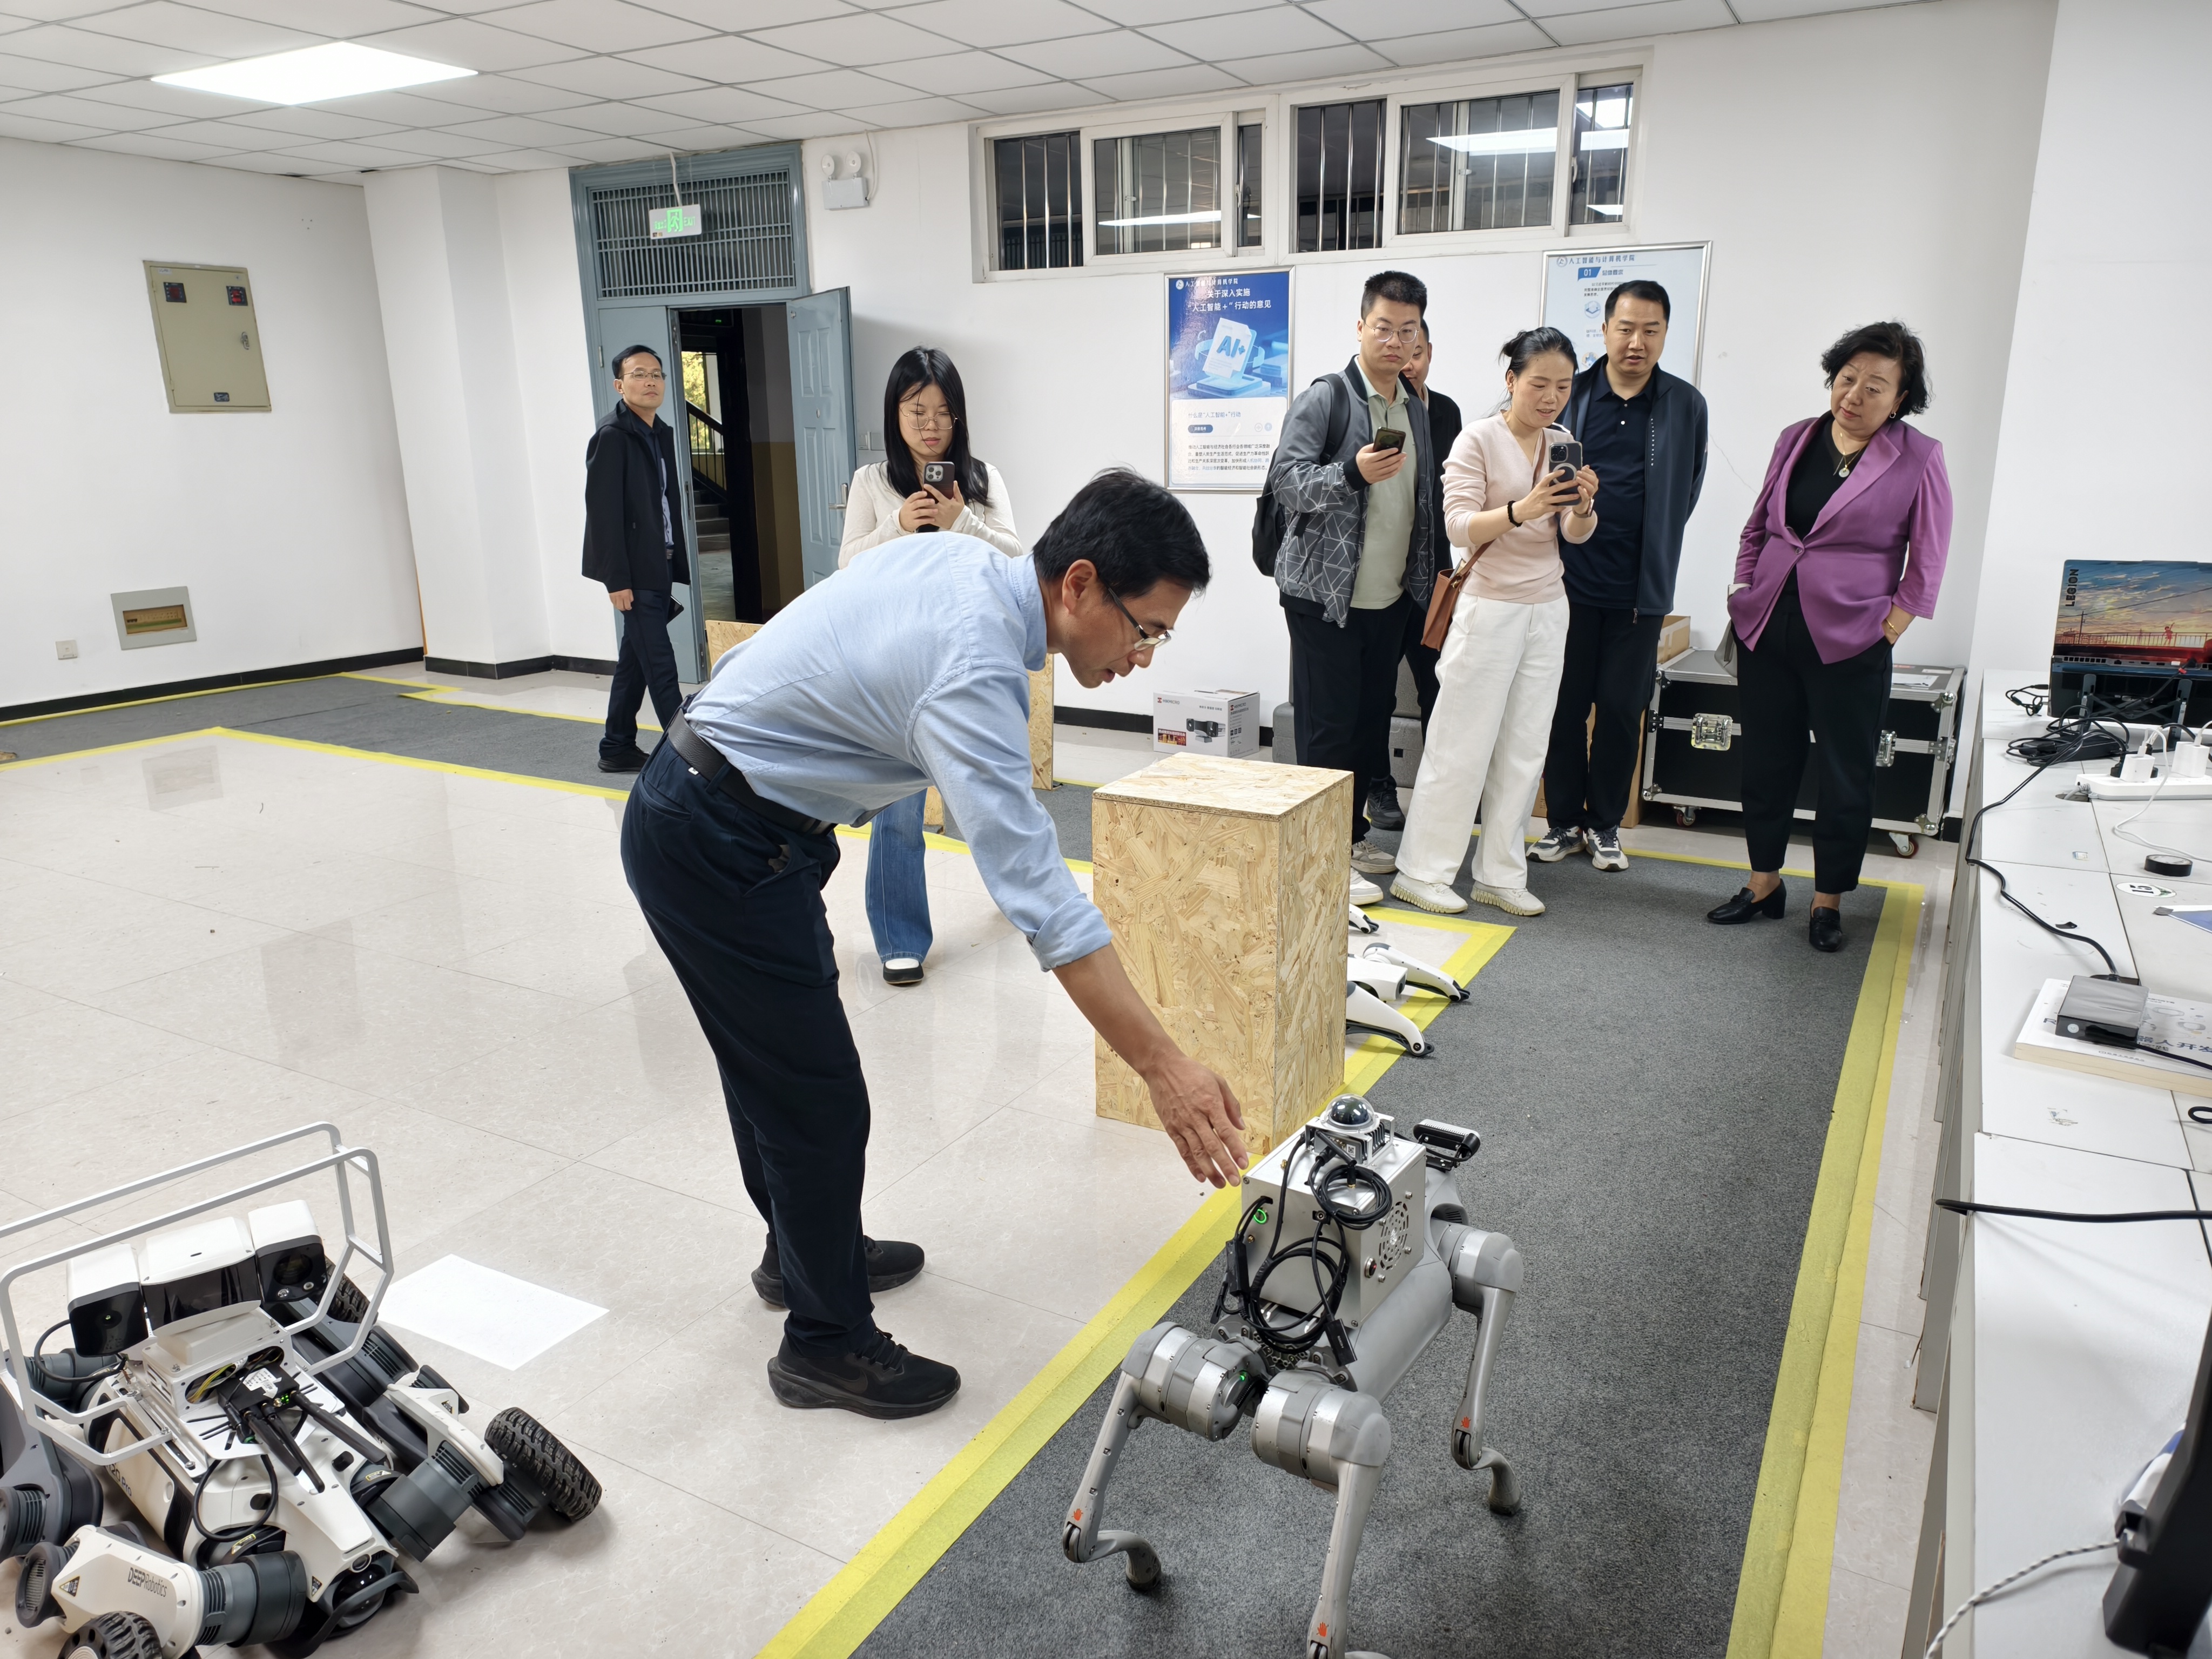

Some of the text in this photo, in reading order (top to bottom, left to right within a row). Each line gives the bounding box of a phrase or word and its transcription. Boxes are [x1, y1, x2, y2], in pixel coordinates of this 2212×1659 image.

[1207, 288, 1250, 298] 关于深入实施
[2065, 569, 2079, 606] LEGION
[2129, 884, 2154, 894] 15
[122, 1476, 132, 1496] Pro
